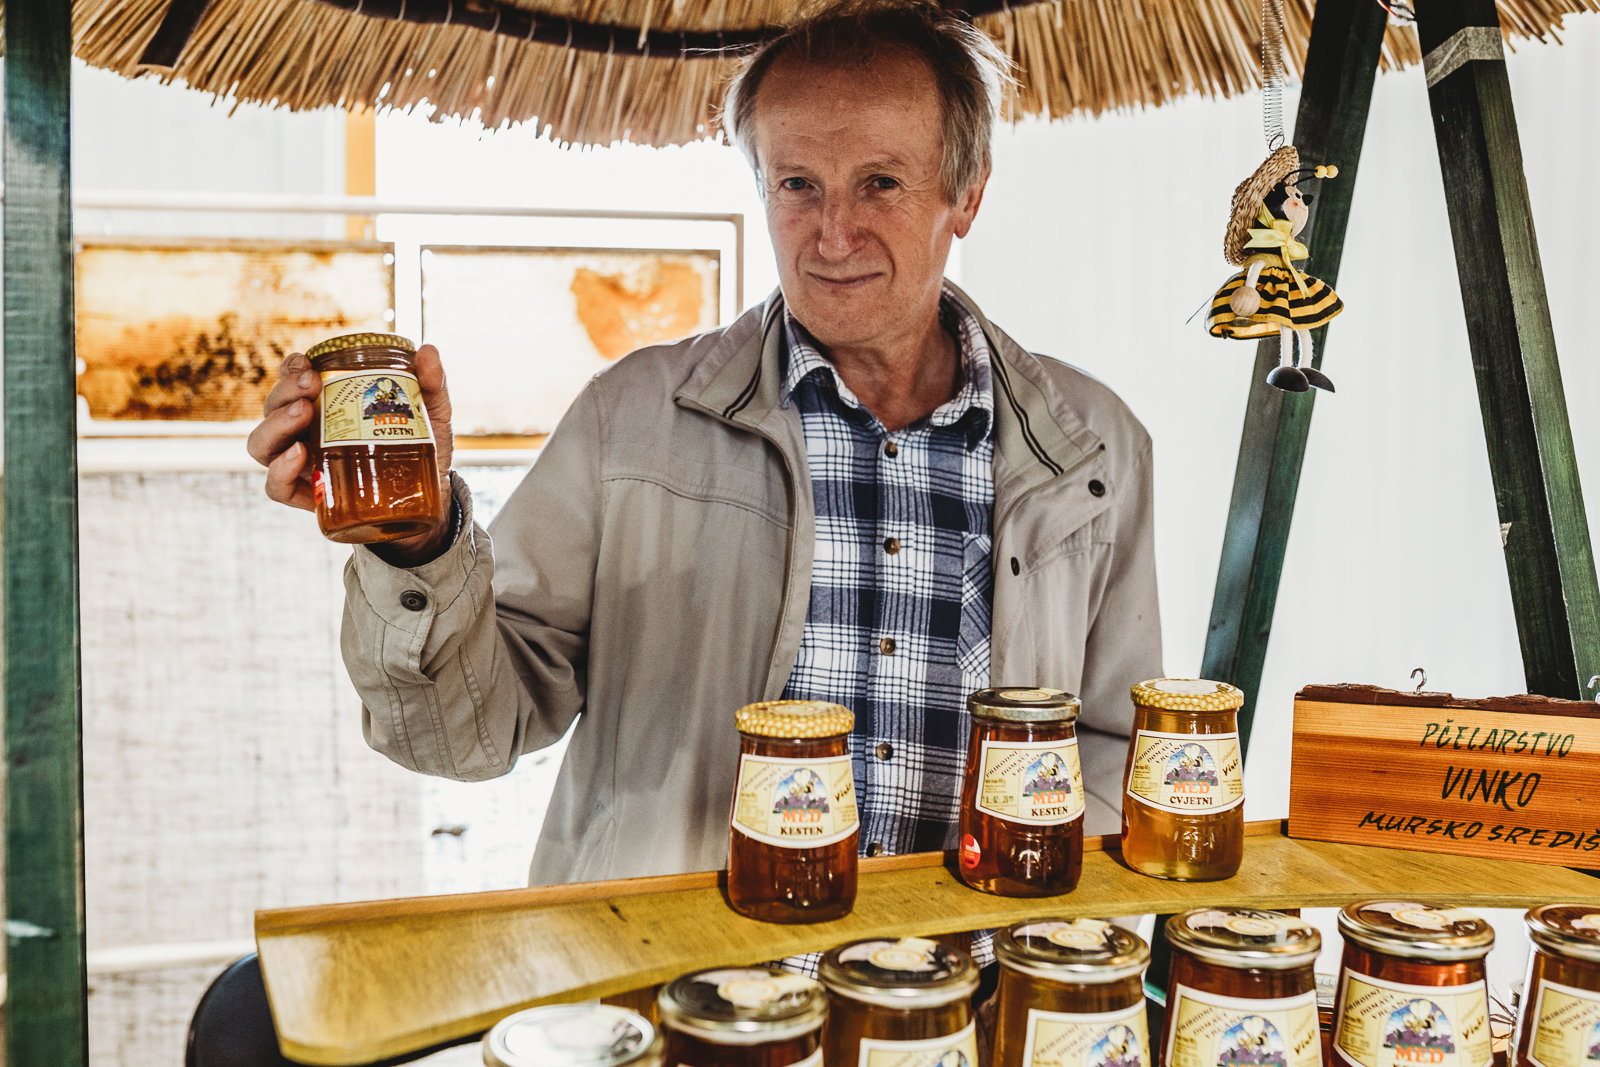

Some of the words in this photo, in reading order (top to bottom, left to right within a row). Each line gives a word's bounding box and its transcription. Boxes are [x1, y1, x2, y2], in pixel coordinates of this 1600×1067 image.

[373, 413, 409, 426] MED
[373, 427, 414, 436] CVJETNI
[1420, 718, 1575, 758] PČELARSTVO
[1173, 781, 1211, 794] MED
[1442, 765, 1541, 811] VINKO
[1032, 791, 1067, 805] MED
[1169, 796, 1213, 805] CVJETNI
[782, 809, 822, 823] MED
[1031, 806, 1068, 817] KESTEN
[780, 826, 823, 836] KESTEN
[1358, 811, 1484, 840] MURSKO
[1395, 1044, 1445, 1064] MED
